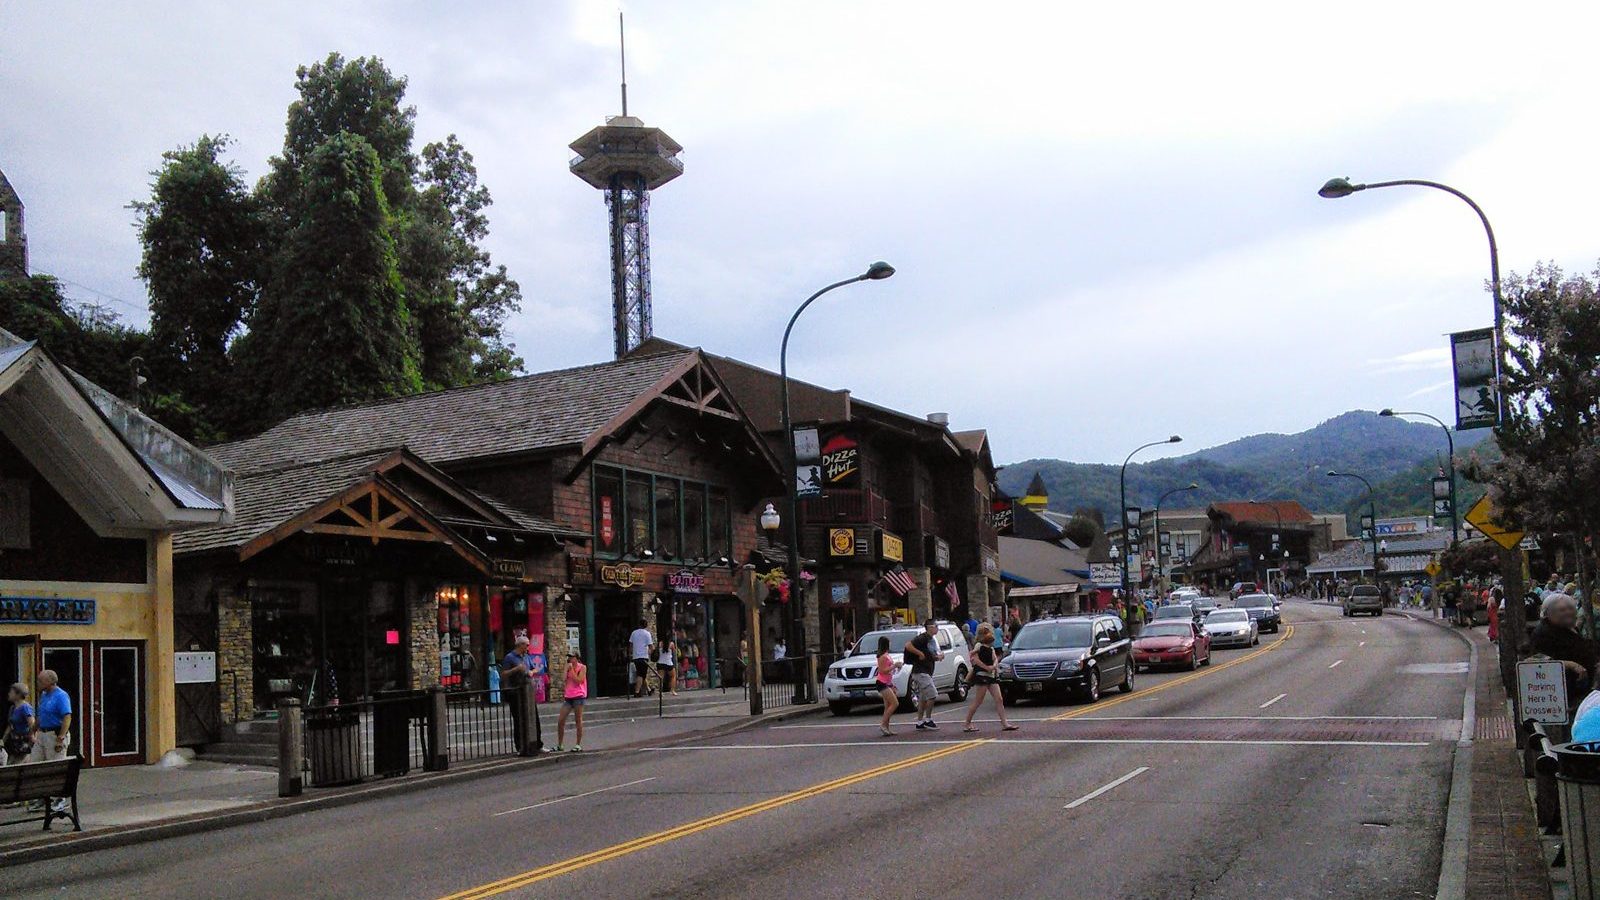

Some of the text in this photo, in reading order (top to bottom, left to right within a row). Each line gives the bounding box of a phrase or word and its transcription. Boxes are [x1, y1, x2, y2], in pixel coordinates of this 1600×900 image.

[826, 460, 854, 479] Hut
[1535, 672, 1546, 680] No
[1527, 683, 1556, 693] Parking
[1527, 694, 1558, 703] Here To
[1524, 705, 1563, 715] Crosswalk
